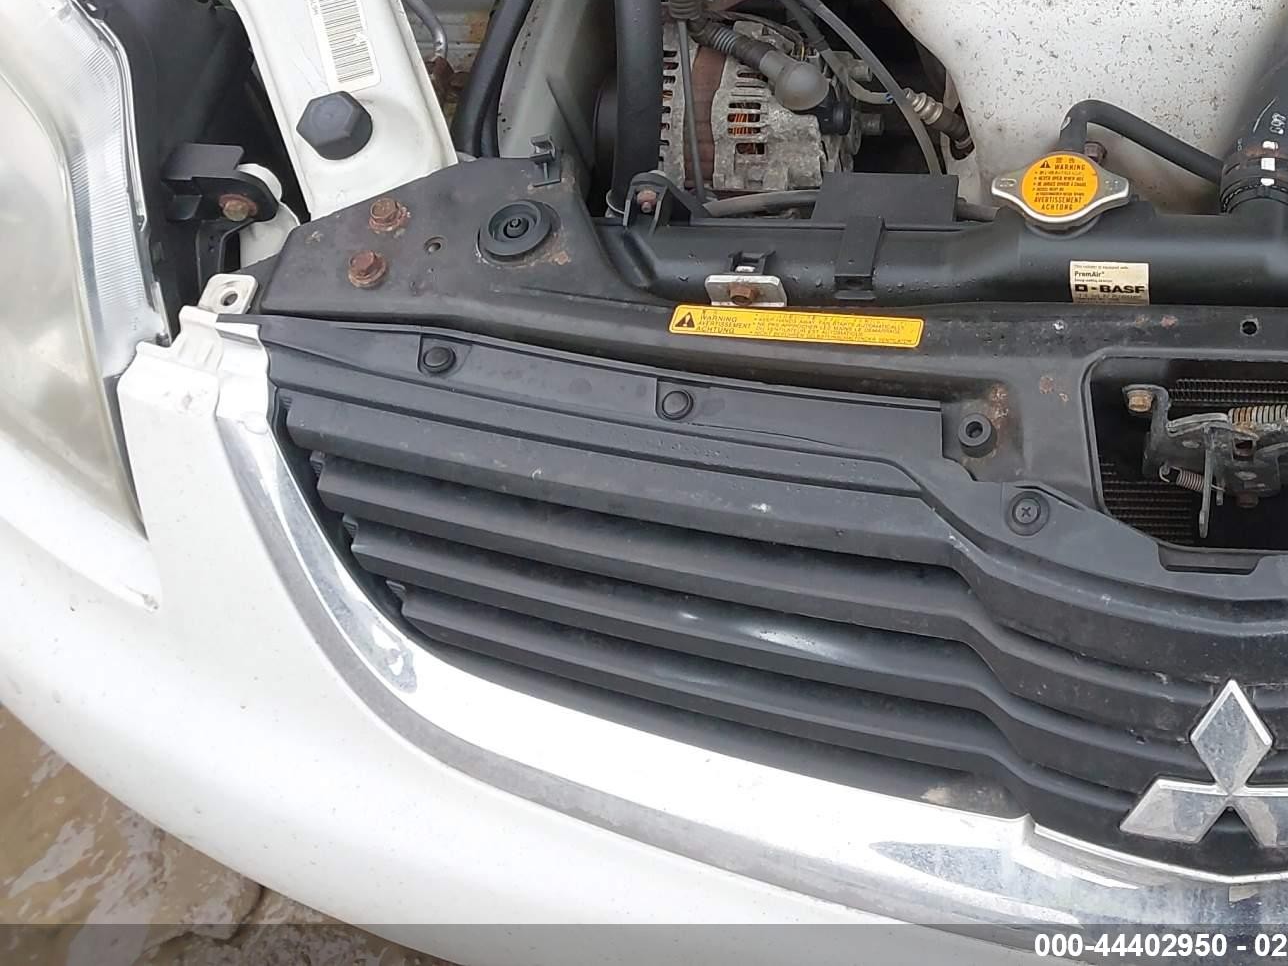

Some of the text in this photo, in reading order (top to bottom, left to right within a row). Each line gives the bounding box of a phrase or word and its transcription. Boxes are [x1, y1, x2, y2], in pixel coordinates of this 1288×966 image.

[1054, 163, 1086, 171] WARNING
[1034, 196, 1082, 204] AVERTISSEMENT
[1041, 203, 1073, 211] ACHTUNG
[1099, 284, 1146, 294] BASF
[700, 314, 737, 323] WARNING
[698, 320, 752, 329] AVERTISSEMENT
[696, 326, 735, 334] ACHTUNG
